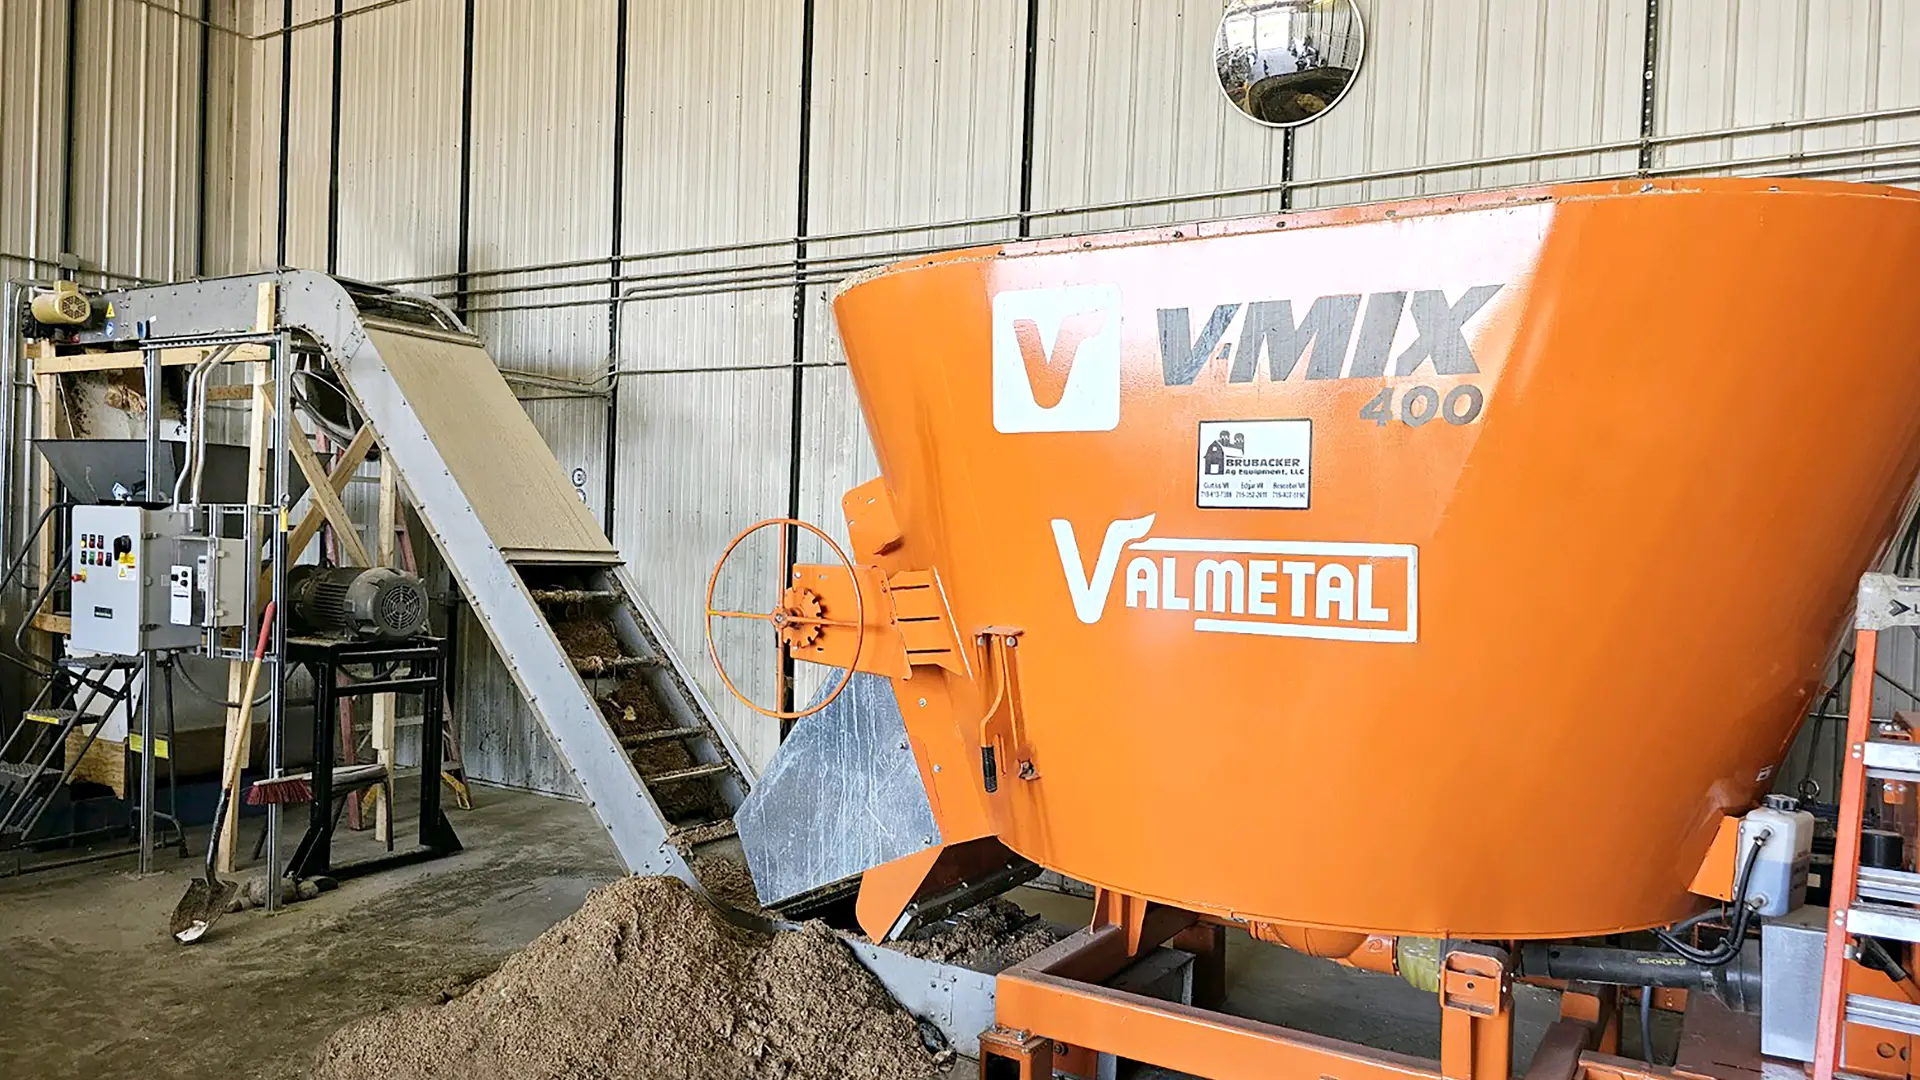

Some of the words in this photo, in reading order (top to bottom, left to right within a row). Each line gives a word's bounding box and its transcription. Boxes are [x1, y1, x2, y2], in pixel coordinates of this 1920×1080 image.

[1359, 384, 1484, 428] 400
[1225, 468, 1237, 476] Ag
[1238, 468, 1288, 476] Equipment,
[1226, 458, 1301, 467] BRUBACKER
[1051, 512, 1389, 623] VALMETAL
